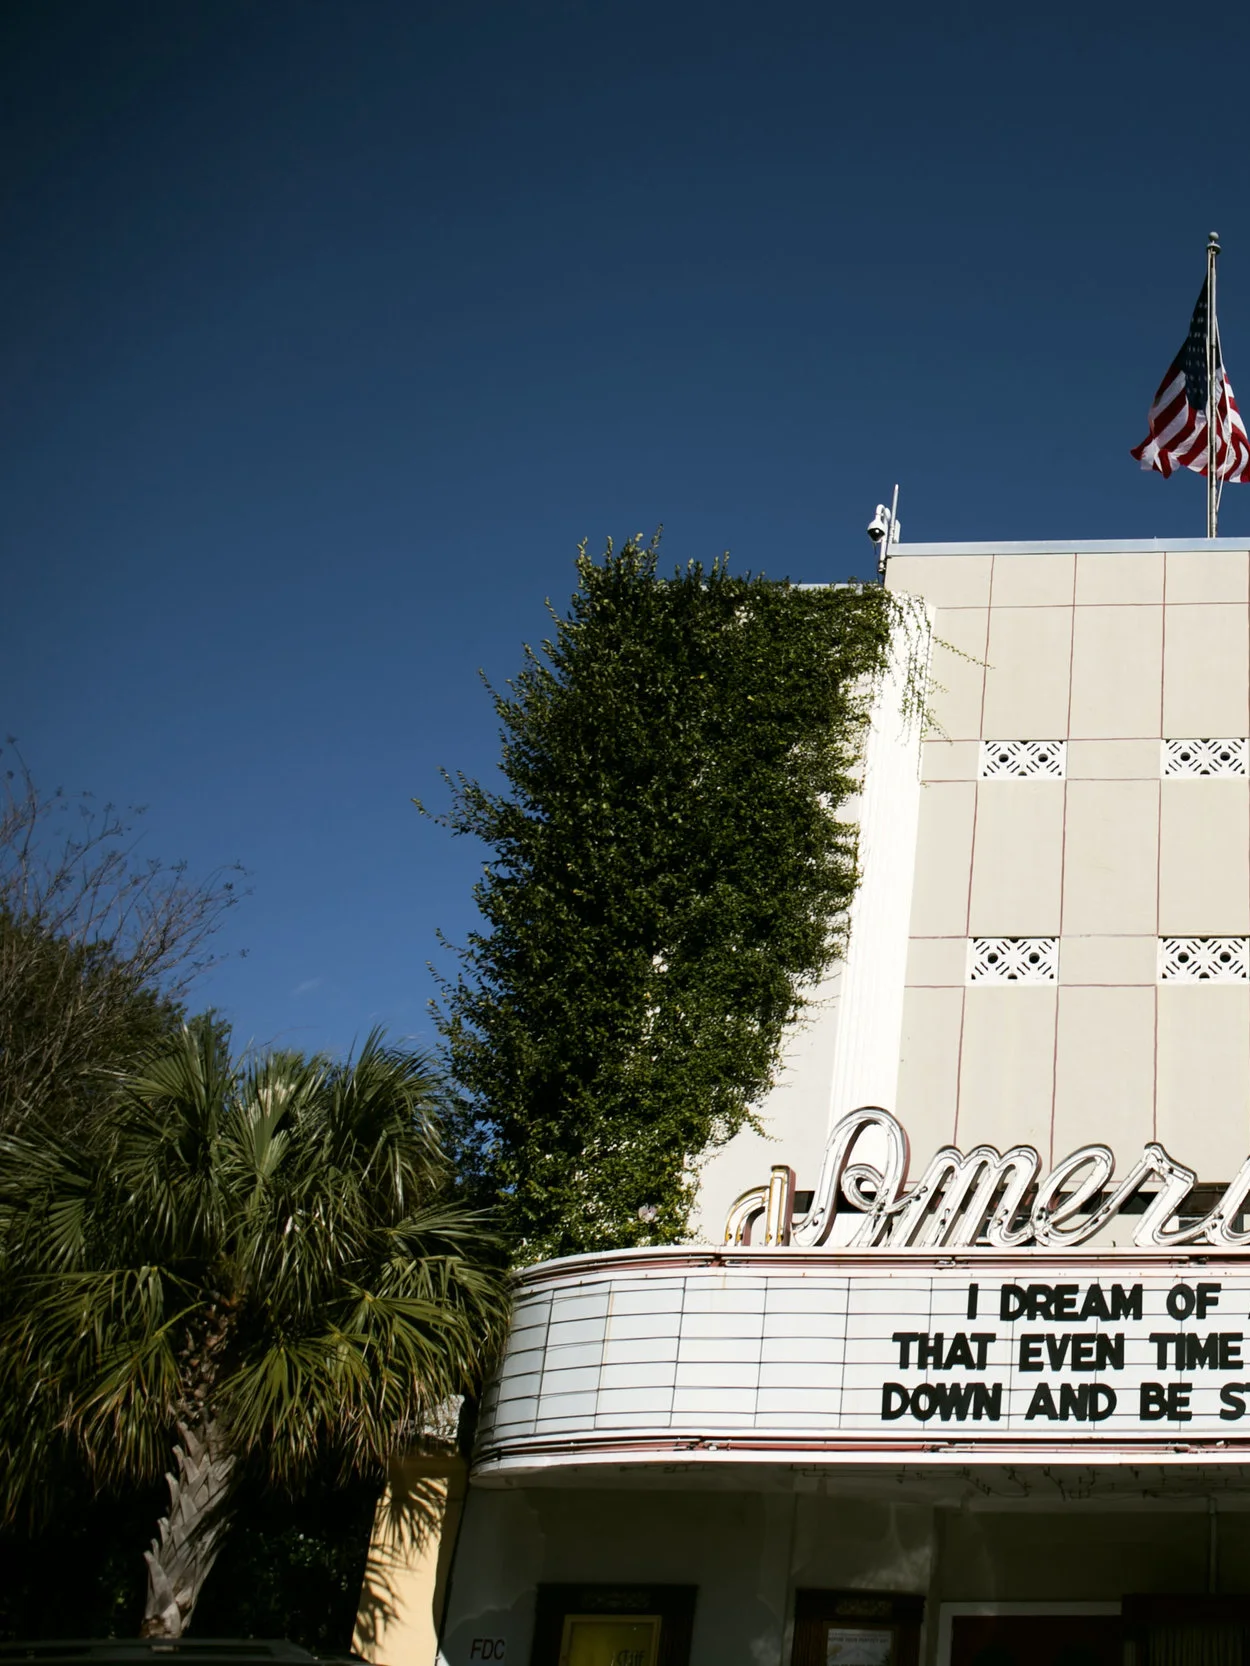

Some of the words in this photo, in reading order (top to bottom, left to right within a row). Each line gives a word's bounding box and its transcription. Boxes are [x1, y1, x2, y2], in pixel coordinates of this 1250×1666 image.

[968, 1284, 979, 1321] I
[1000, 1284, 1143, 1322] DREAM
[1167, 1284, 1222, 1321] OF
[893, 1333, 997, 1371] THAT
[1019, 1333, 1126, 1372] EVEN
[1150, 1333, 1244, 1371] TIME
[882, 1383, 1003, 1422] DOWN
[1026, 1383, 1117, 1422] AND
[1140, 1383, 1194, 1422] BE
[470, 1638, 505, 1661] FDC
